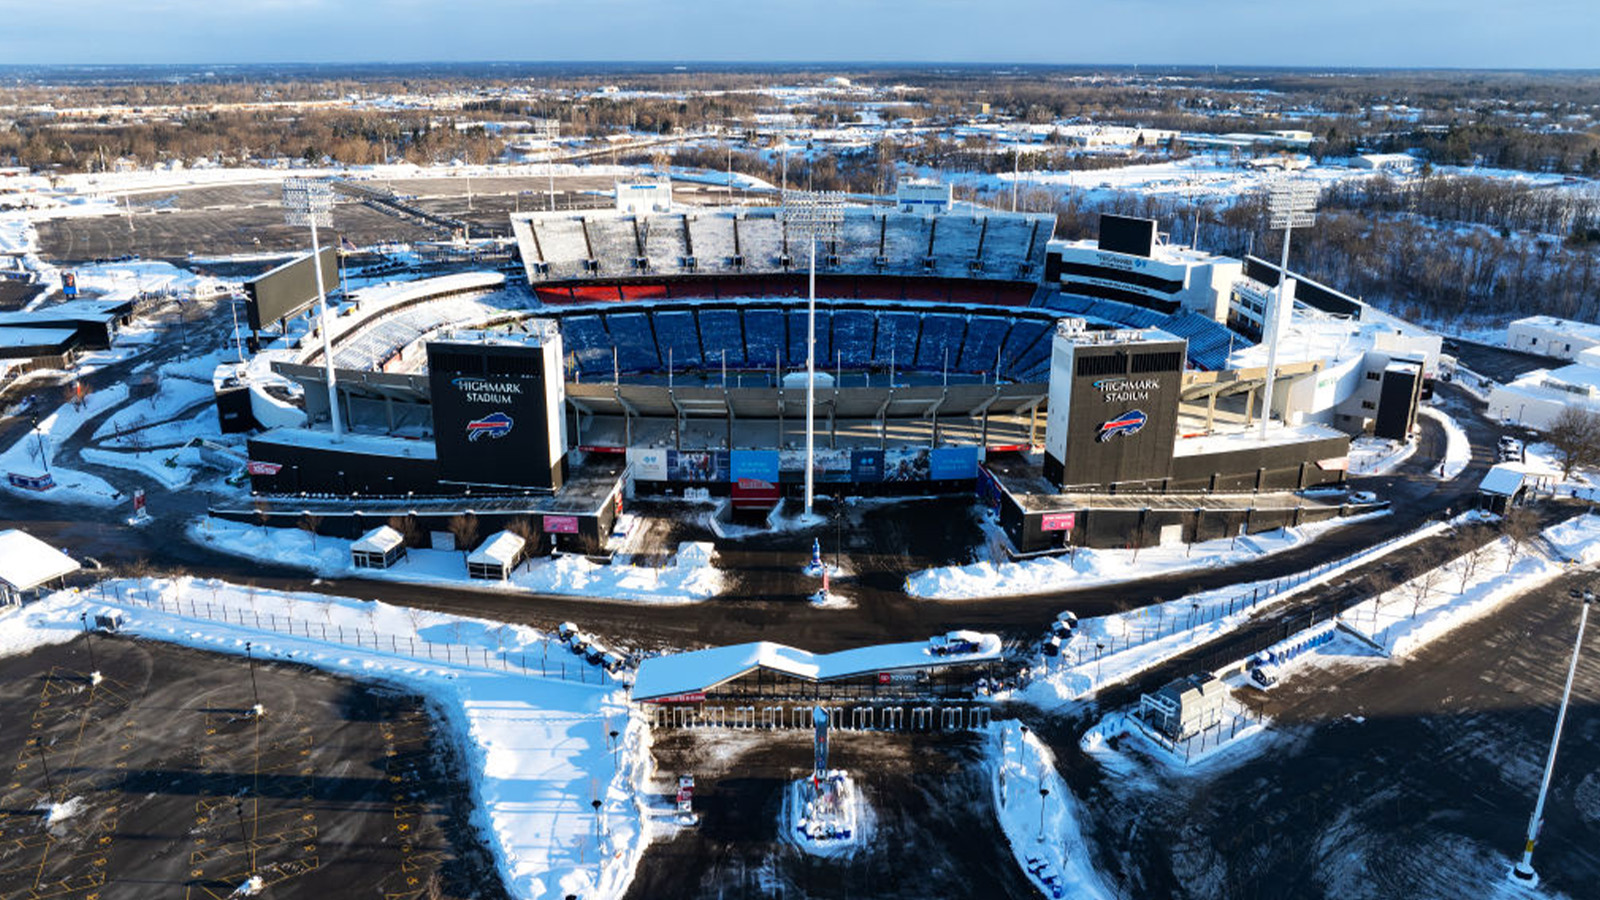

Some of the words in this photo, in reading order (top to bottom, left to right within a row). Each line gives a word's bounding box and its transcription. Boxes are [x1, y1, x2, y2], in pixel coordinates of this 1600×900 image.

[458, 380, 521, 393] HIGHMARK
[1100, 379, 1160, 392] HIGHMARK
[466, 392, 511, 403] STADIUM
[1105, 392, 1149, 403] STADIUM
